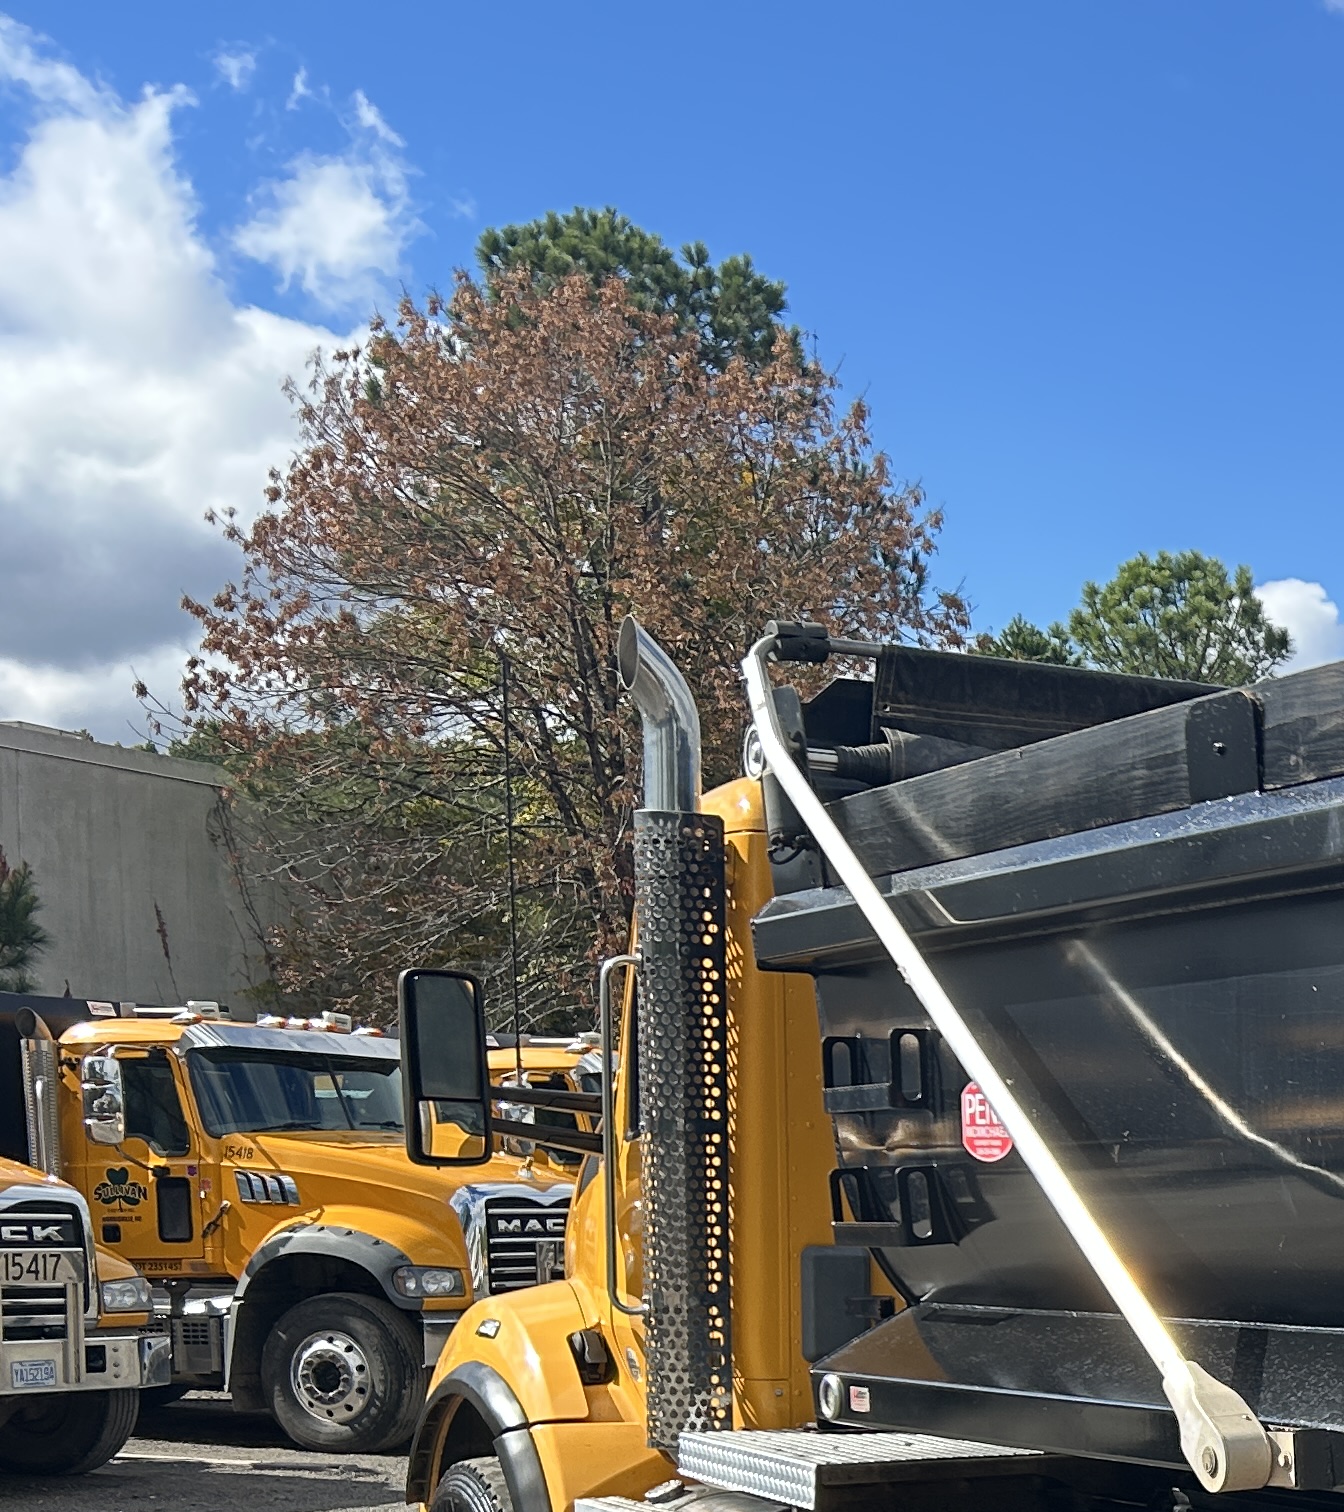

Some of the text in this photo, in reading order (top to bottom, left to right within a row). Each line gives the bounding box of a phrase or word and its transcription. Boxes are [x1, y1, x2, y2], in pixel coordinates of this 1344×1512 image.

[965, 1094, 1002, 1125] PEN
[224, 1145, 254, 1160] 15418
[93, 1184, 148, 1201] SULLIVAN
[1, 1226, 64, 1241] CK
[498, 1219, 565, 1232] MAC
[3, 1253, 61, 1281] 15417
